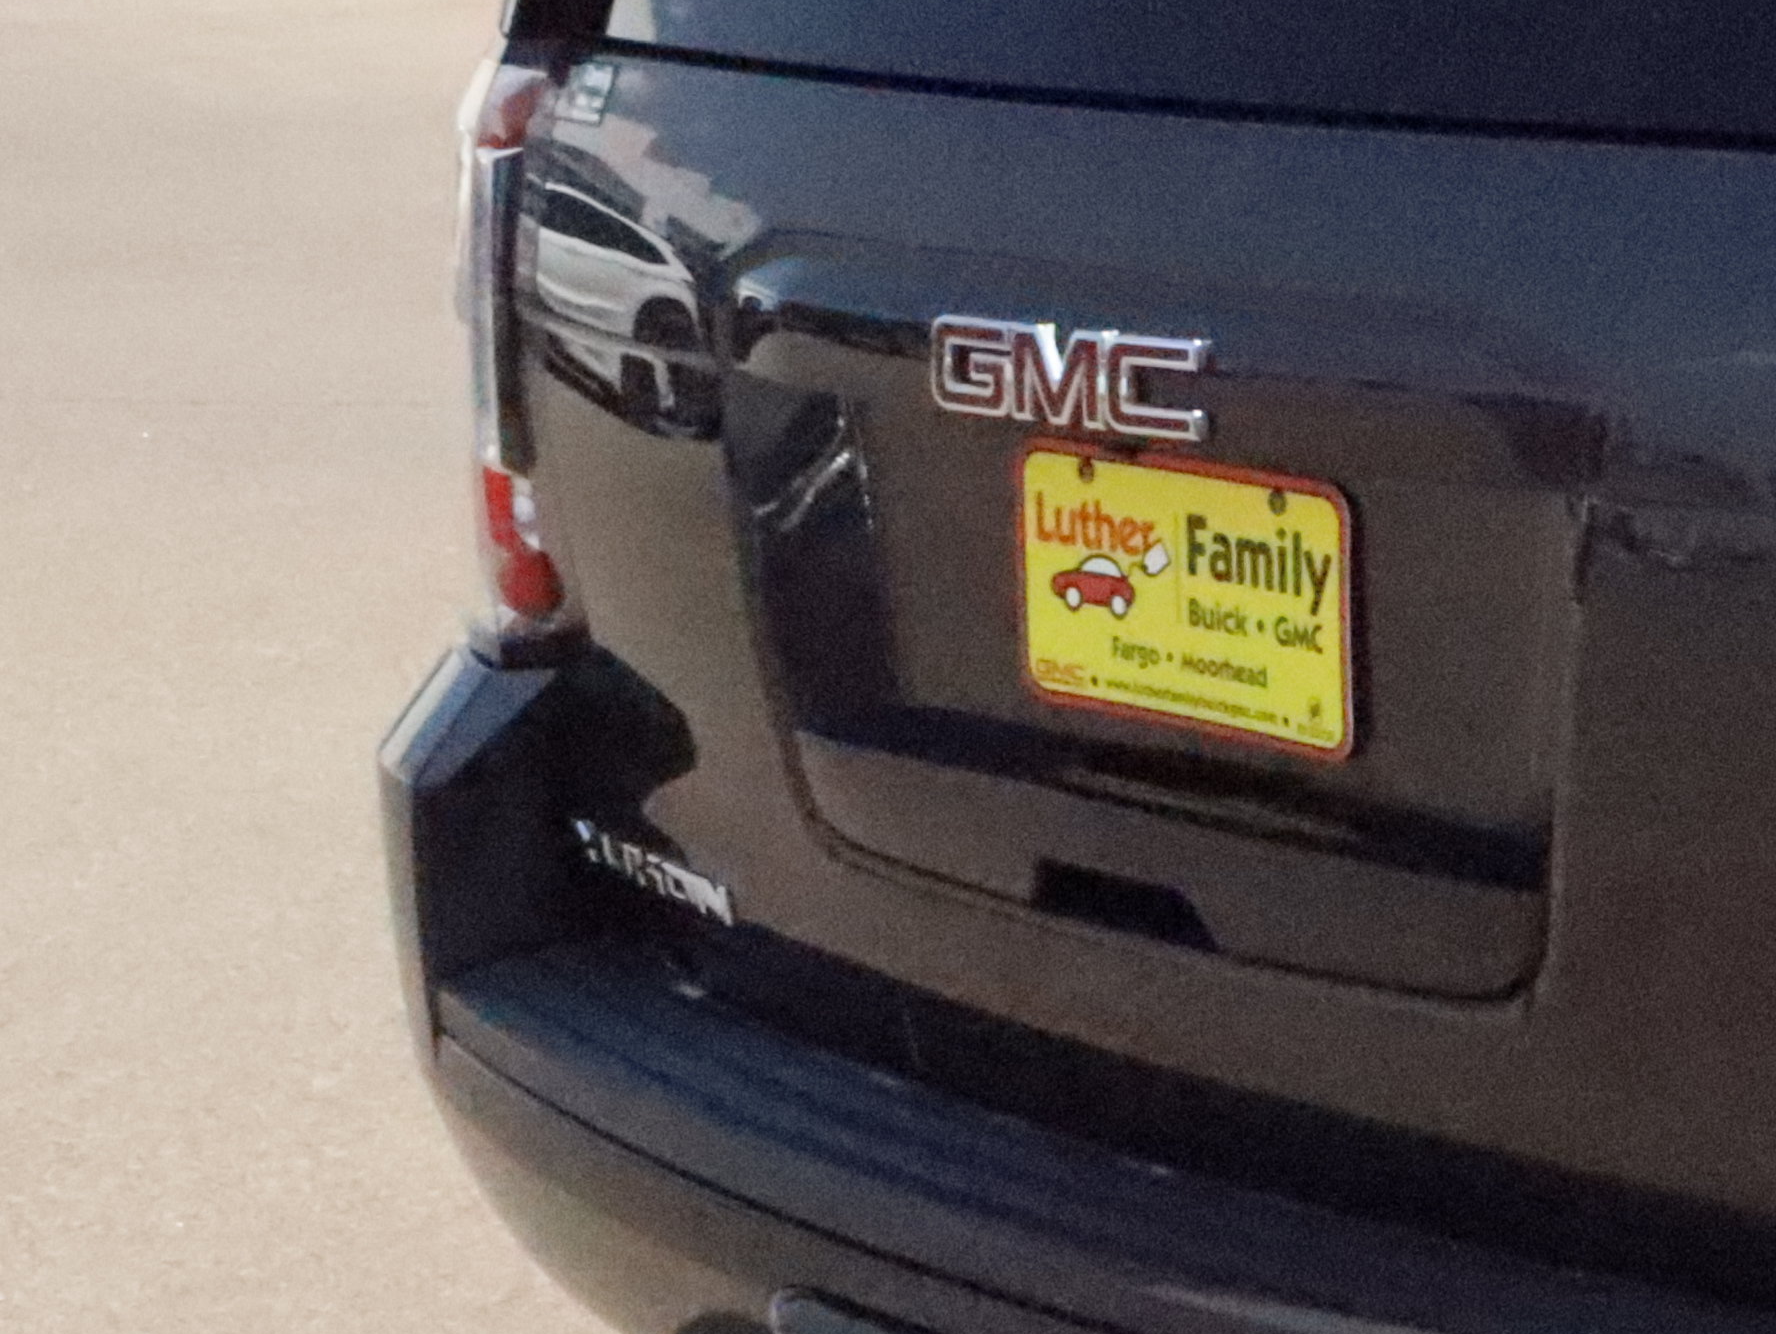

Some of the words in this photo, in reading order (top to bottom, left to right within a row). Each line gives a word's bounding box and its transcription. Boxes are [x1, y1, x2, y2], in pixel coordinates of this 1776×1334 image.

[931, 314, 1213, 441] GMC
[1035, 491, 1157, 556] Luther
[1187, 513, 1332, 616] Family
[1188, 598, 1248, 637] Buick
[1274, 616, 1324, 655] GMC
[1111, 636, 1162, 669] Fargo
[1180, 652, 1269, 688] Moorhead
